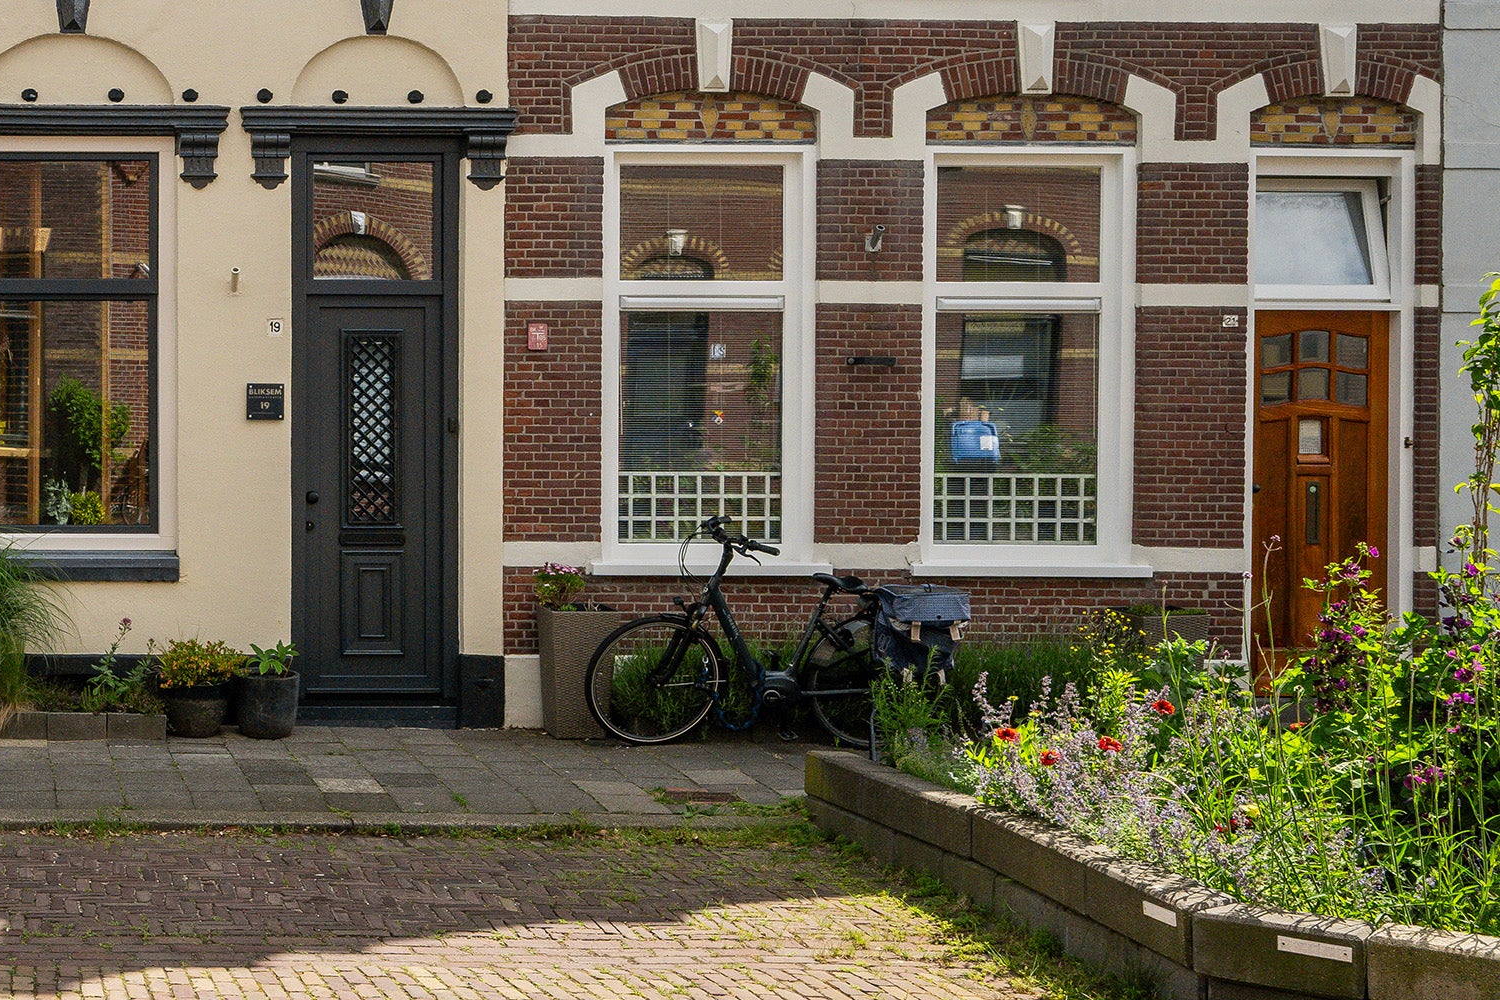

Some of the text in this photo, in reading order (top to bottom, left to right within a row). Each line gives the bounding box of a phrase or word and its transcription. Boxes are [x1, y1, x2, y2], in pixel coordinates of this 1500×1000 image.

[1225, 317, 1236, 326] 21
[270, 321, 281, 332] 19
[248, 388, 282, 396] BLIKSEM
[260, 401, 270, 410] 19
